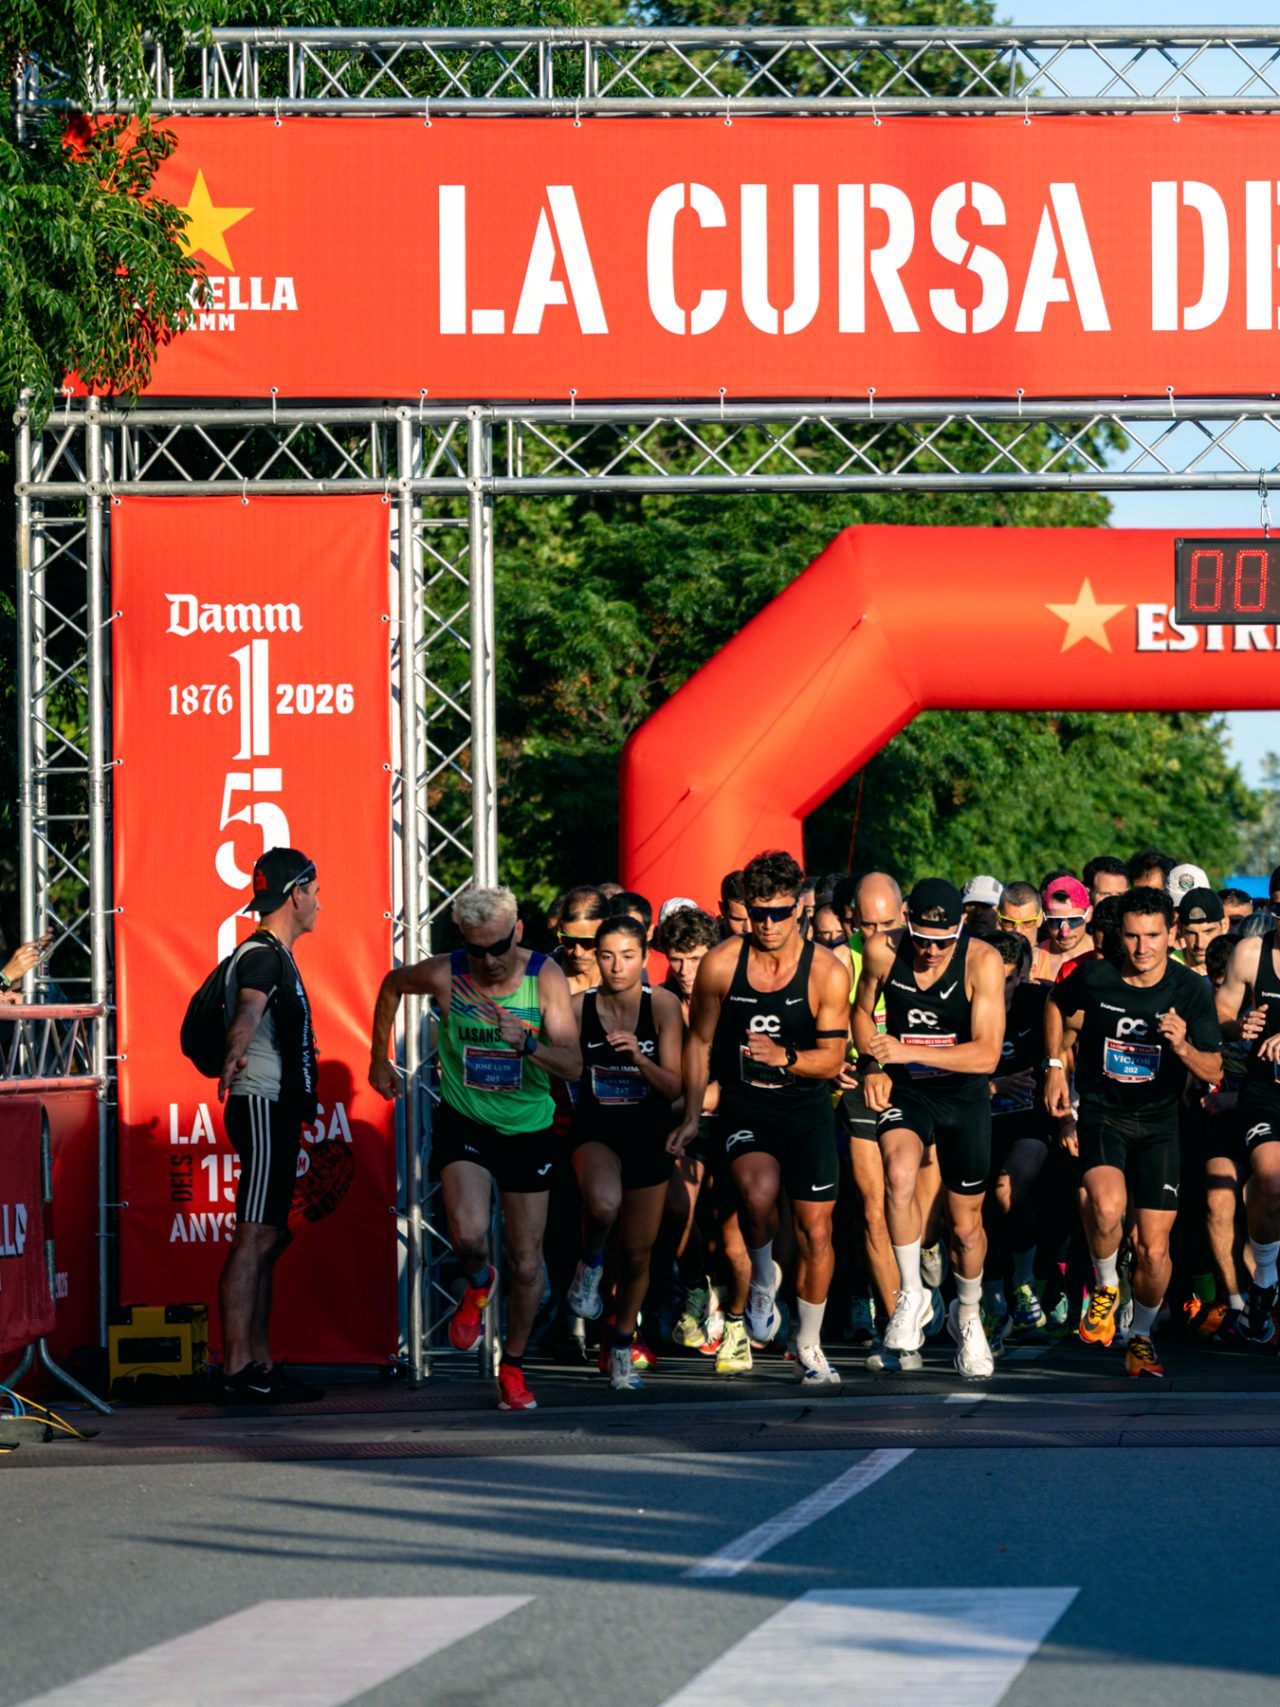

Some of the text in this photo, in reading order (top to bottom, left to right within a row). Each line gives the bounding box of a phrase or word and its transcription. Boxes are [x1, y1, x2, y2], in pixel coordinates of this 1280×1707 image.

[439, 185, 608, 335] LA
[647, 182, 1111, 335] CURSA
[1189, 549, 1269, 613] 00
[165, 593, 303, 637] Damm
[169, 683, 354, 715] 1876 2026
[1113, 1054, 1151, 1066] VICTOR
[1123, 1066, 1138, 1074] 202
[169, 1103, 217, 1144] LA
[171, 1154, 193, 1203] DELS
[201, 1154, 242, 1203] 15
